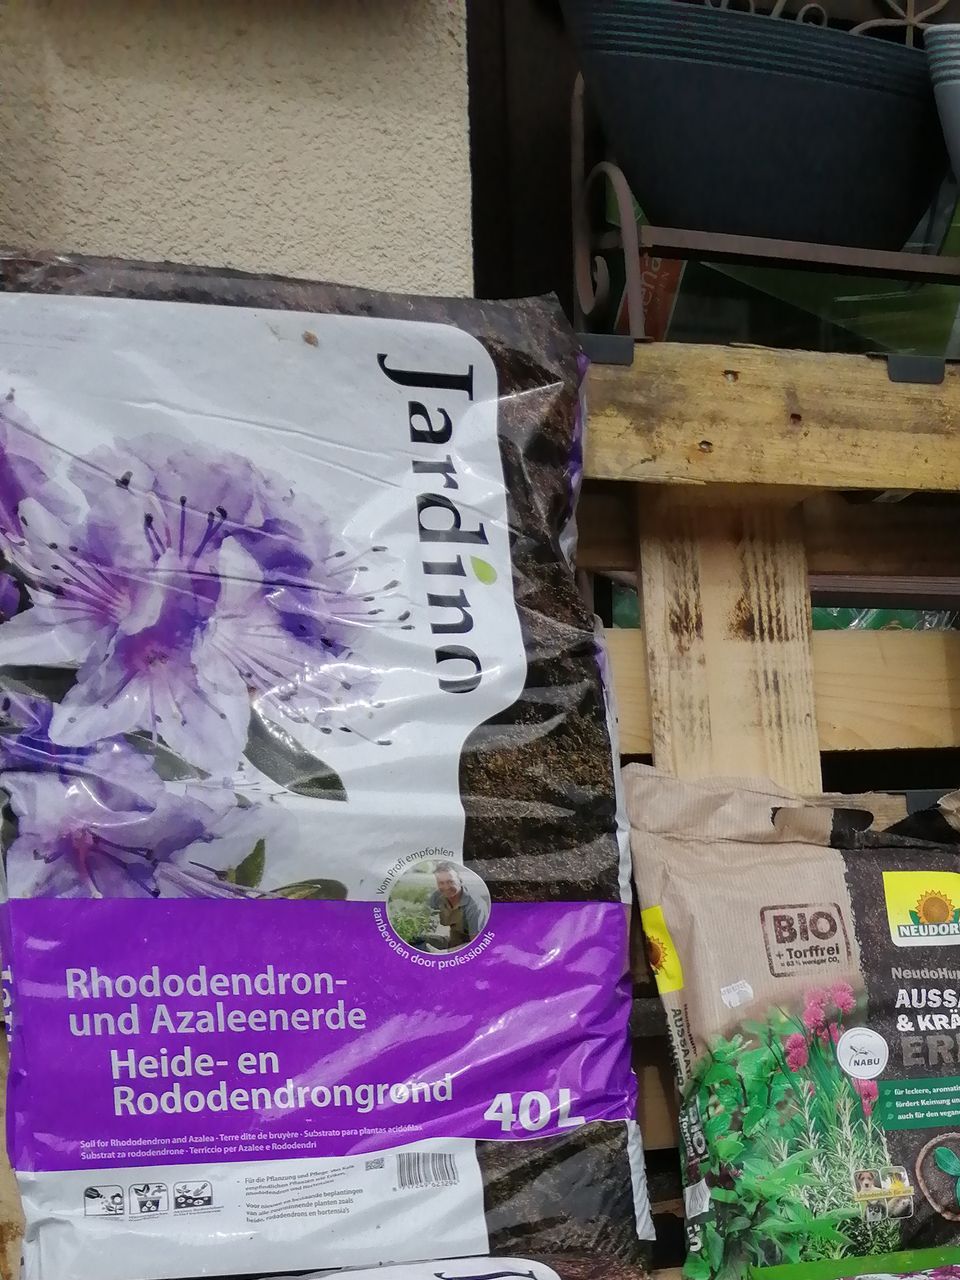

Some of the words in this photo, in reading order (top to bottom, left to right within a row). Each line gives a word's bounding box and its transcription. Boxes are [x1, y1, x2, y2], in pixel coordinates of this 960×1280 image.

[376, 353, 498, 694] Jardino
[376, 878, 392, 896] Vom
[390, 857, 406, 878] Profi
[405, 846, 455, 863] empfohlen
[373, 906, 410, 959] aanbevolen
[411, 954, 436, 968] door
[438, 931, 496, 970] professionals
[772, 911, 838, 944] BIO
[787, 943, 840, 960] Torffrei
[66, 965, 348, 999] Rhododendron-
[69, 1006, 145, 1036] und
[150, 1000, 368, 1036] Azaleenerde
[895, 1014, 915, 1032] &
[111, 1046, 229, 1080] Heide-
[237, 1050, 280, 1075] en
[853, 1058, 881, 1067] NABU
[113, 1073, 454, 1117] Rododendrongrond
[893, 1087, 904, 1096] für
[905, 1086, 932, 1096] leckere,
[895, 1099, 918, 1109] fördert
[918, 1097, 951, 1109] Keimung
[484, 1088, 586, 1134] 40L
[897, 1111, 914, 1121] auch
[914, 1111, 925, 1119] für
[925, 1110, 939, 1119] den
[80, 1140, 96, 1149] Soil
[96, 1139, 109, 1148] for
[110, 1136, 170, 1147] Rhododendron
[171, 1135, 187, 1144] and
[188, 1134, 215, 1144] Azalea
[219, 1132, 240, 1142] Terre
[257, 1131, 268, 1140] de
[268, 1129, 299, 1141] bruyère
[303, 1129, 342, 1139] Substrato
[342, 1128, 359, 1138] para
[359, 1126, 387, 1137] plantas
[80, 1151, 113, 1161] Substrat
[114, 1151, 126, 1159] za
[126, 1147, 185, 1159] rododendrone
[188, 1145, 222, 1156] Terriccio
[222, 1146, 237, 1155] per
[238, 1143, 264, 1153] Azalee
[265, 1144, 271, 1152] e
[271, 1141, 317, 1152] Rododendri
